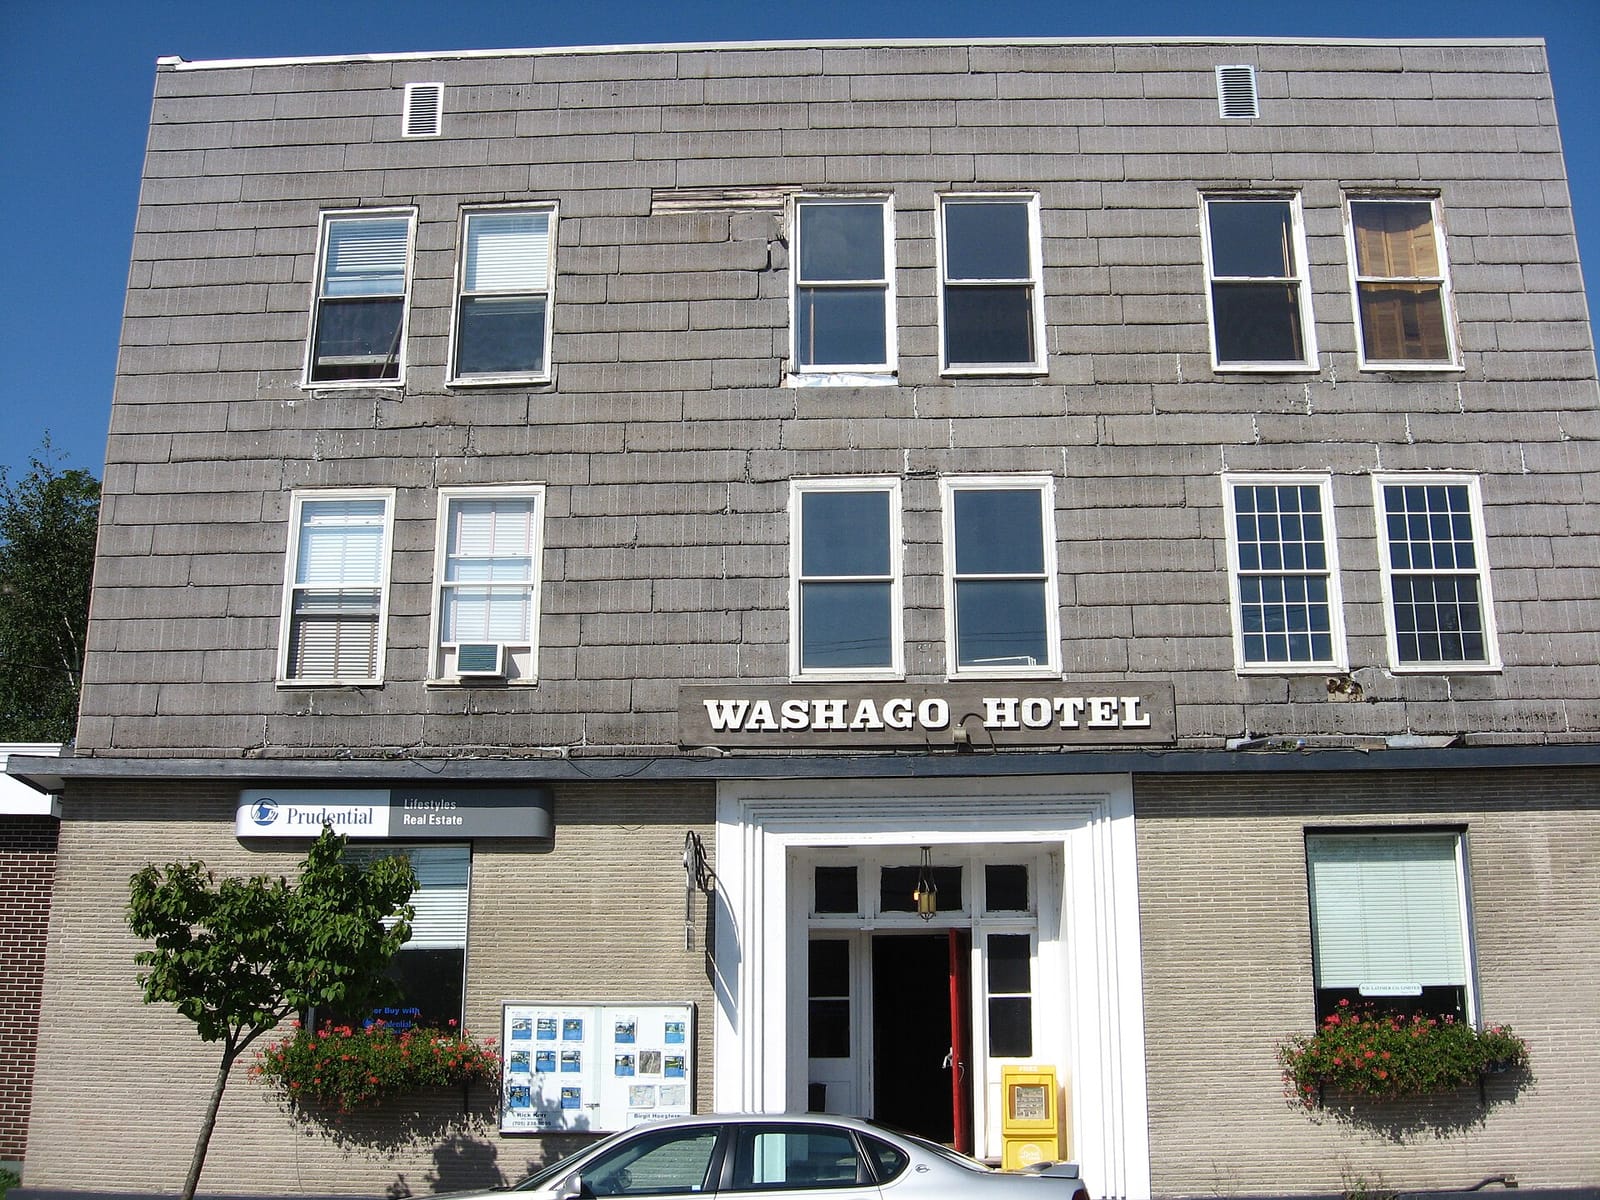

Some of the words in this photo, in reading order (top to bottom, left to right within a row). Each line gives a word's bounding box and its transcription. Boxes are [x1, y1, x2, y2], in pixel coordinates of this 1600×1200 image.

[703, 698, 950, 731] WASHAGO
[983, 696, 1151, 729] HOTEL
[404, 798, 457, 812] Lifestyles
[286, 807, 373, 825] Prudential
[403, 813, 427, 825] Real
[428, 813, 463, 825] Estate
[384, 1007, 400, 1016] Buy
[402, 1007, 420, 1015] with
